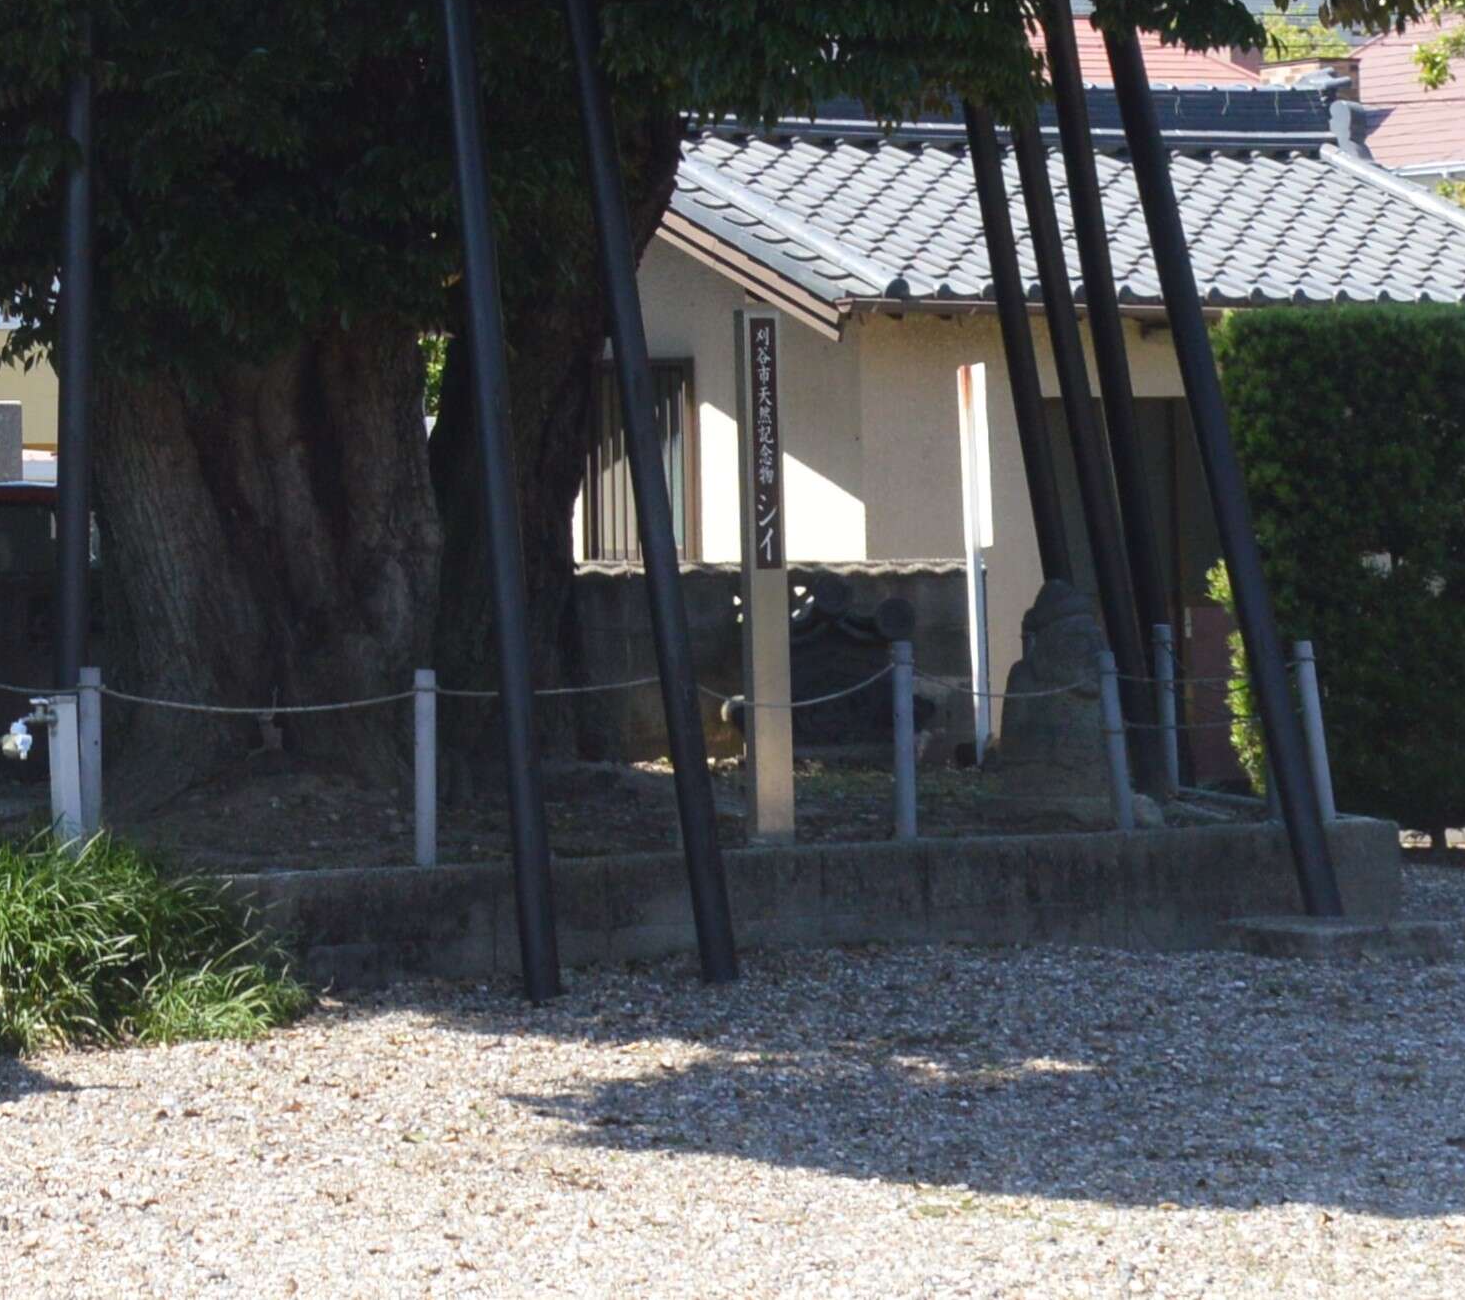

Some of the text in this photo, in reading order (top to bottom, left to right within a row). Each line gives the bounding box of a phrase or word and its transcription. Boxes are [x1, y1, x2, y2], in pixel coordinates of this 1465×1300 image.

[755, 326, 778, 563] 刈谷市天然記念物 シイ
